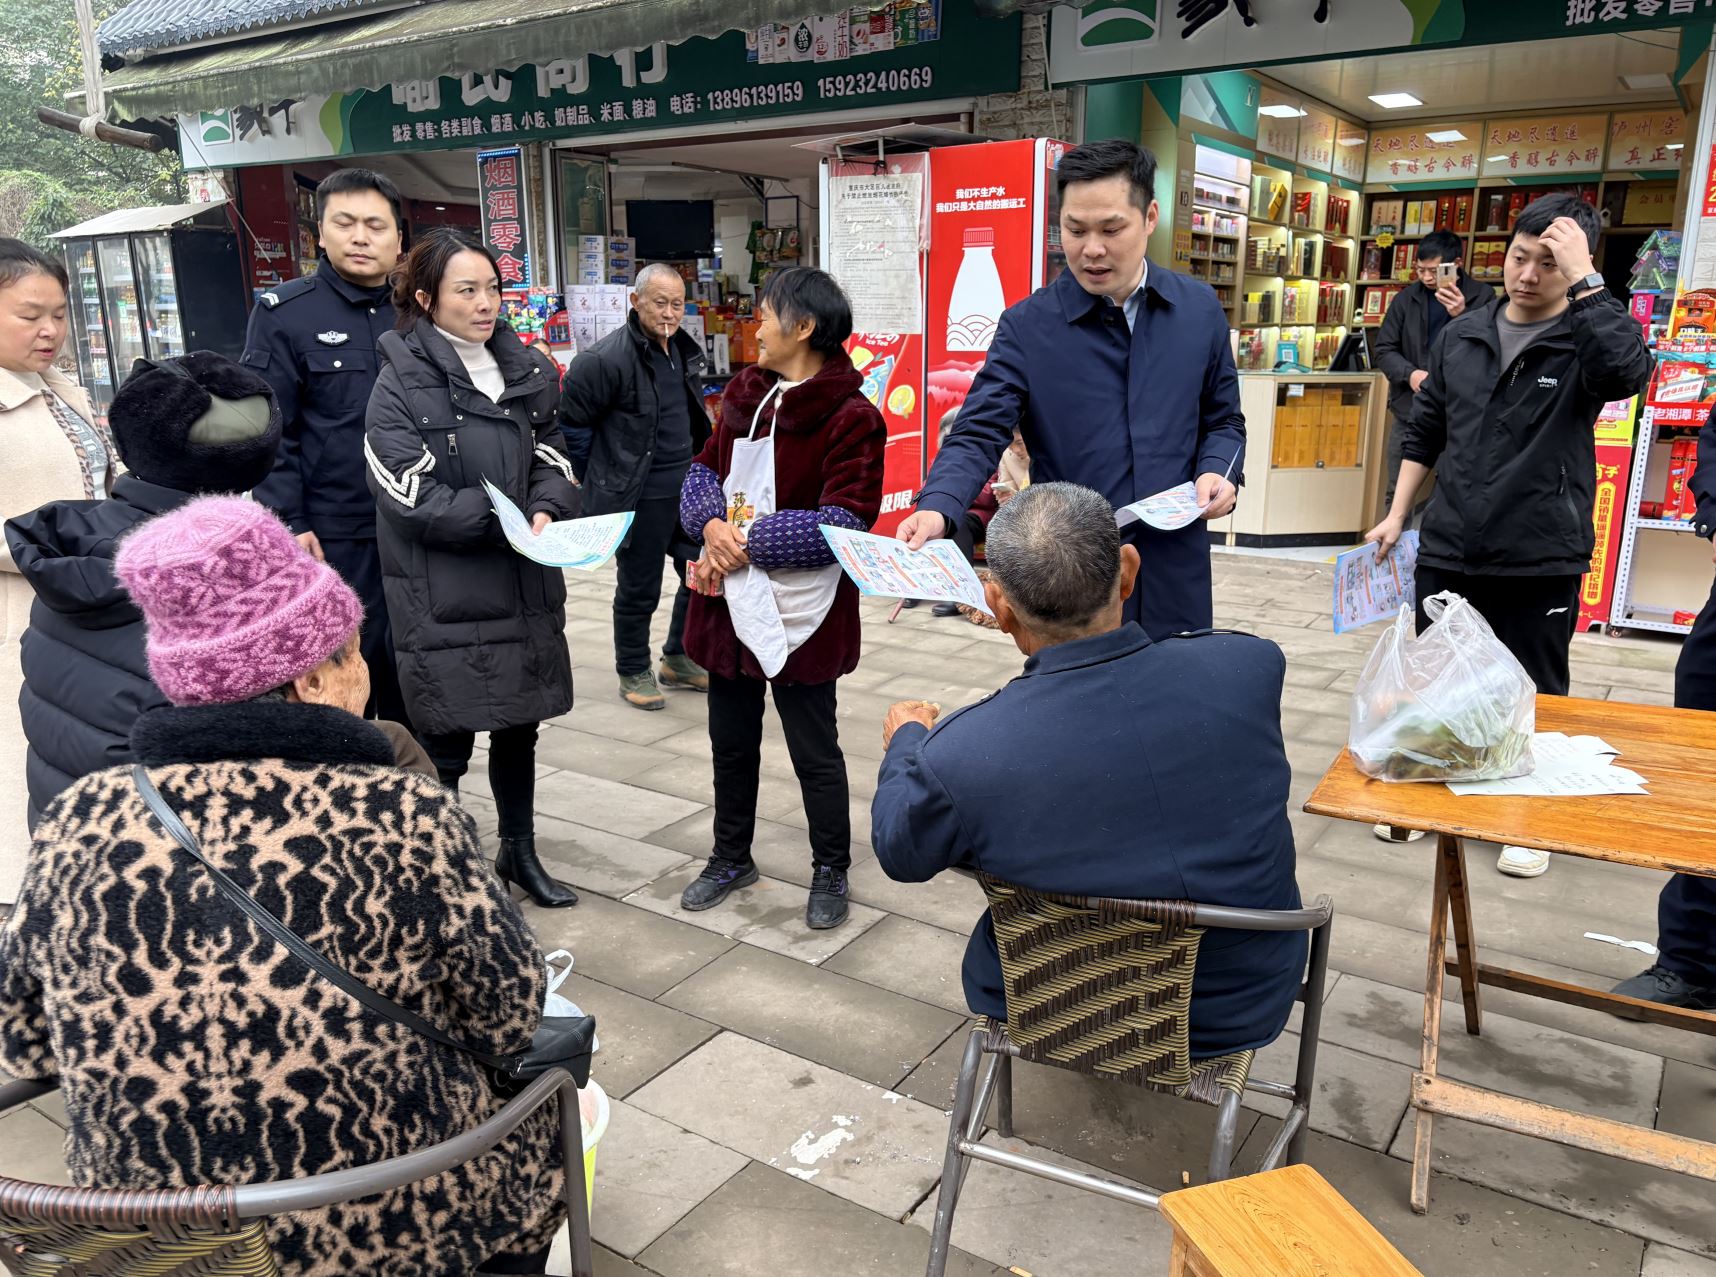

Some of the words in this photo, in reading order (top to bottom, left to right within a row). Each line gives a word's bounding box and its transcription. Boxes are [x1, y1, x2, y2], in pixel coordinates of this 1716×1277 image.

[392, 124, 412, 143] 批发
[707, 81, 803, 111] 13896139159
[817, 66, 932, 98] 15923240669
[956, 186, 1006, 199] 我们不生产水
[936, 198, 1026, 213] 我们只是大自然的搬运工
[485, 157, 523, 282] 烟酒零食
[876, 339, 889, 347] Tea
[1537, 376, 1558, 385] Jeep
